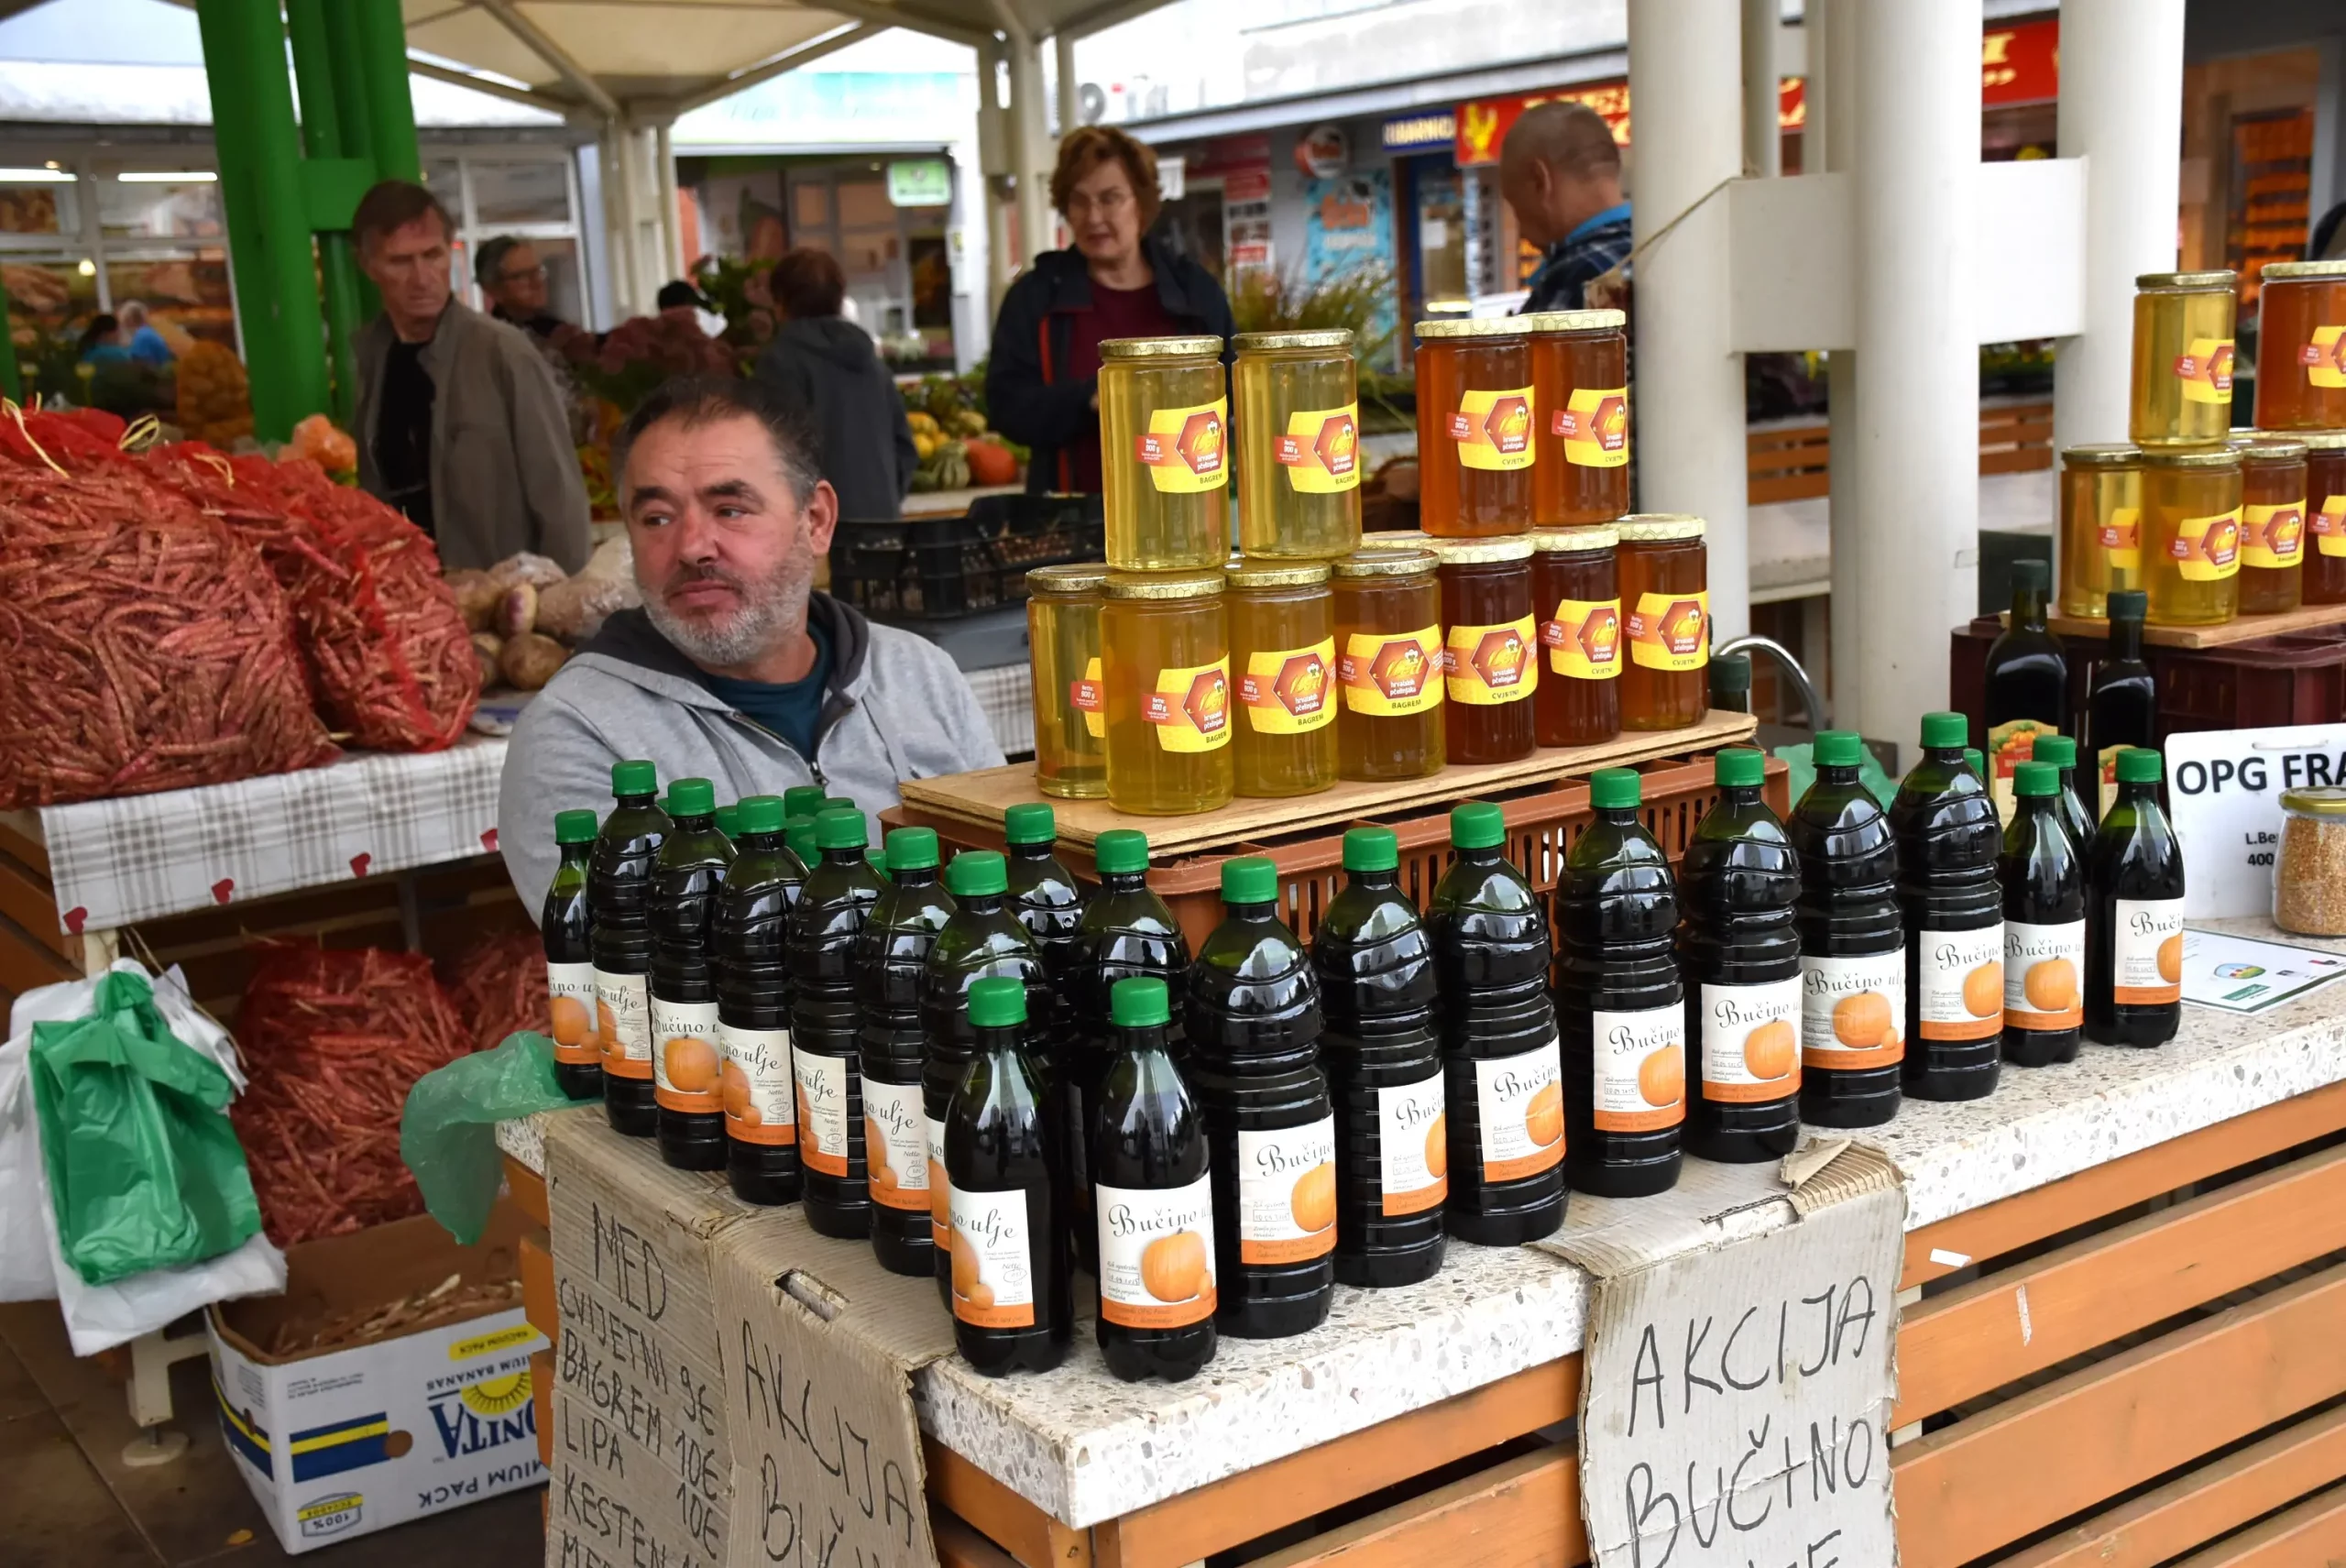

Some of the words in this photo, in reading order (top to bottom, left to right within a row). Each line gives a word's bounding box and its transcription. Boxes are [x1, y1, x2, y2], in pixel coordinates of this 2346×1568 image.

[1199, 473, 1222, 484] BAGREM
[1391, 698, 1421, 709] BAGREM
[1297, 713, 1324, 726] BAGREM
[1205, 731, 1227, 743] BAGREM
[2176, 756, 2267, 795] OPG
[2245, 831, 2278, 845] L.Be
[1935, 943, 2001, 970] Bučino
[2004, 932, 2071, 959] Bučino
[1804, 969, 1882, 996] Bučino
[609, 985, 641, 1014] ulje
[1715, 999, 1789, 1028] Bučino
[653, 1007, 708, 1034] Bučino
[1608, 1025, 1680, 1055] Bučino
[744, 1043, 783, 1077] ulje
[806, 1069, 838, 1102] ulje
[880, 1099, 918, 1136] ulje
[971, 1209, 1018, 1249] ulje
[1108, 1203, 1198, 1238] Bučino
[592, 1201, 667, 1322] MED
[560, 1277, 668, 1395] CVIJETNI
[1628, 1275, 1876, 1437] AKCIJA
[427, 1363, 495, 1391] BANANAS
[562, 1328, 661, 1457] BAGREM
[564, 1396, 624, 1479] LIPA
[742, 1317, 915, 1550] AKCIJA
[418, 1479, 479, 1509] PACK
[1626, 1414, 1873, 1568] BUČINO
[312, 1511, 351, 1531] 100%
[564, 1463, 666, 1568] KESTEN
